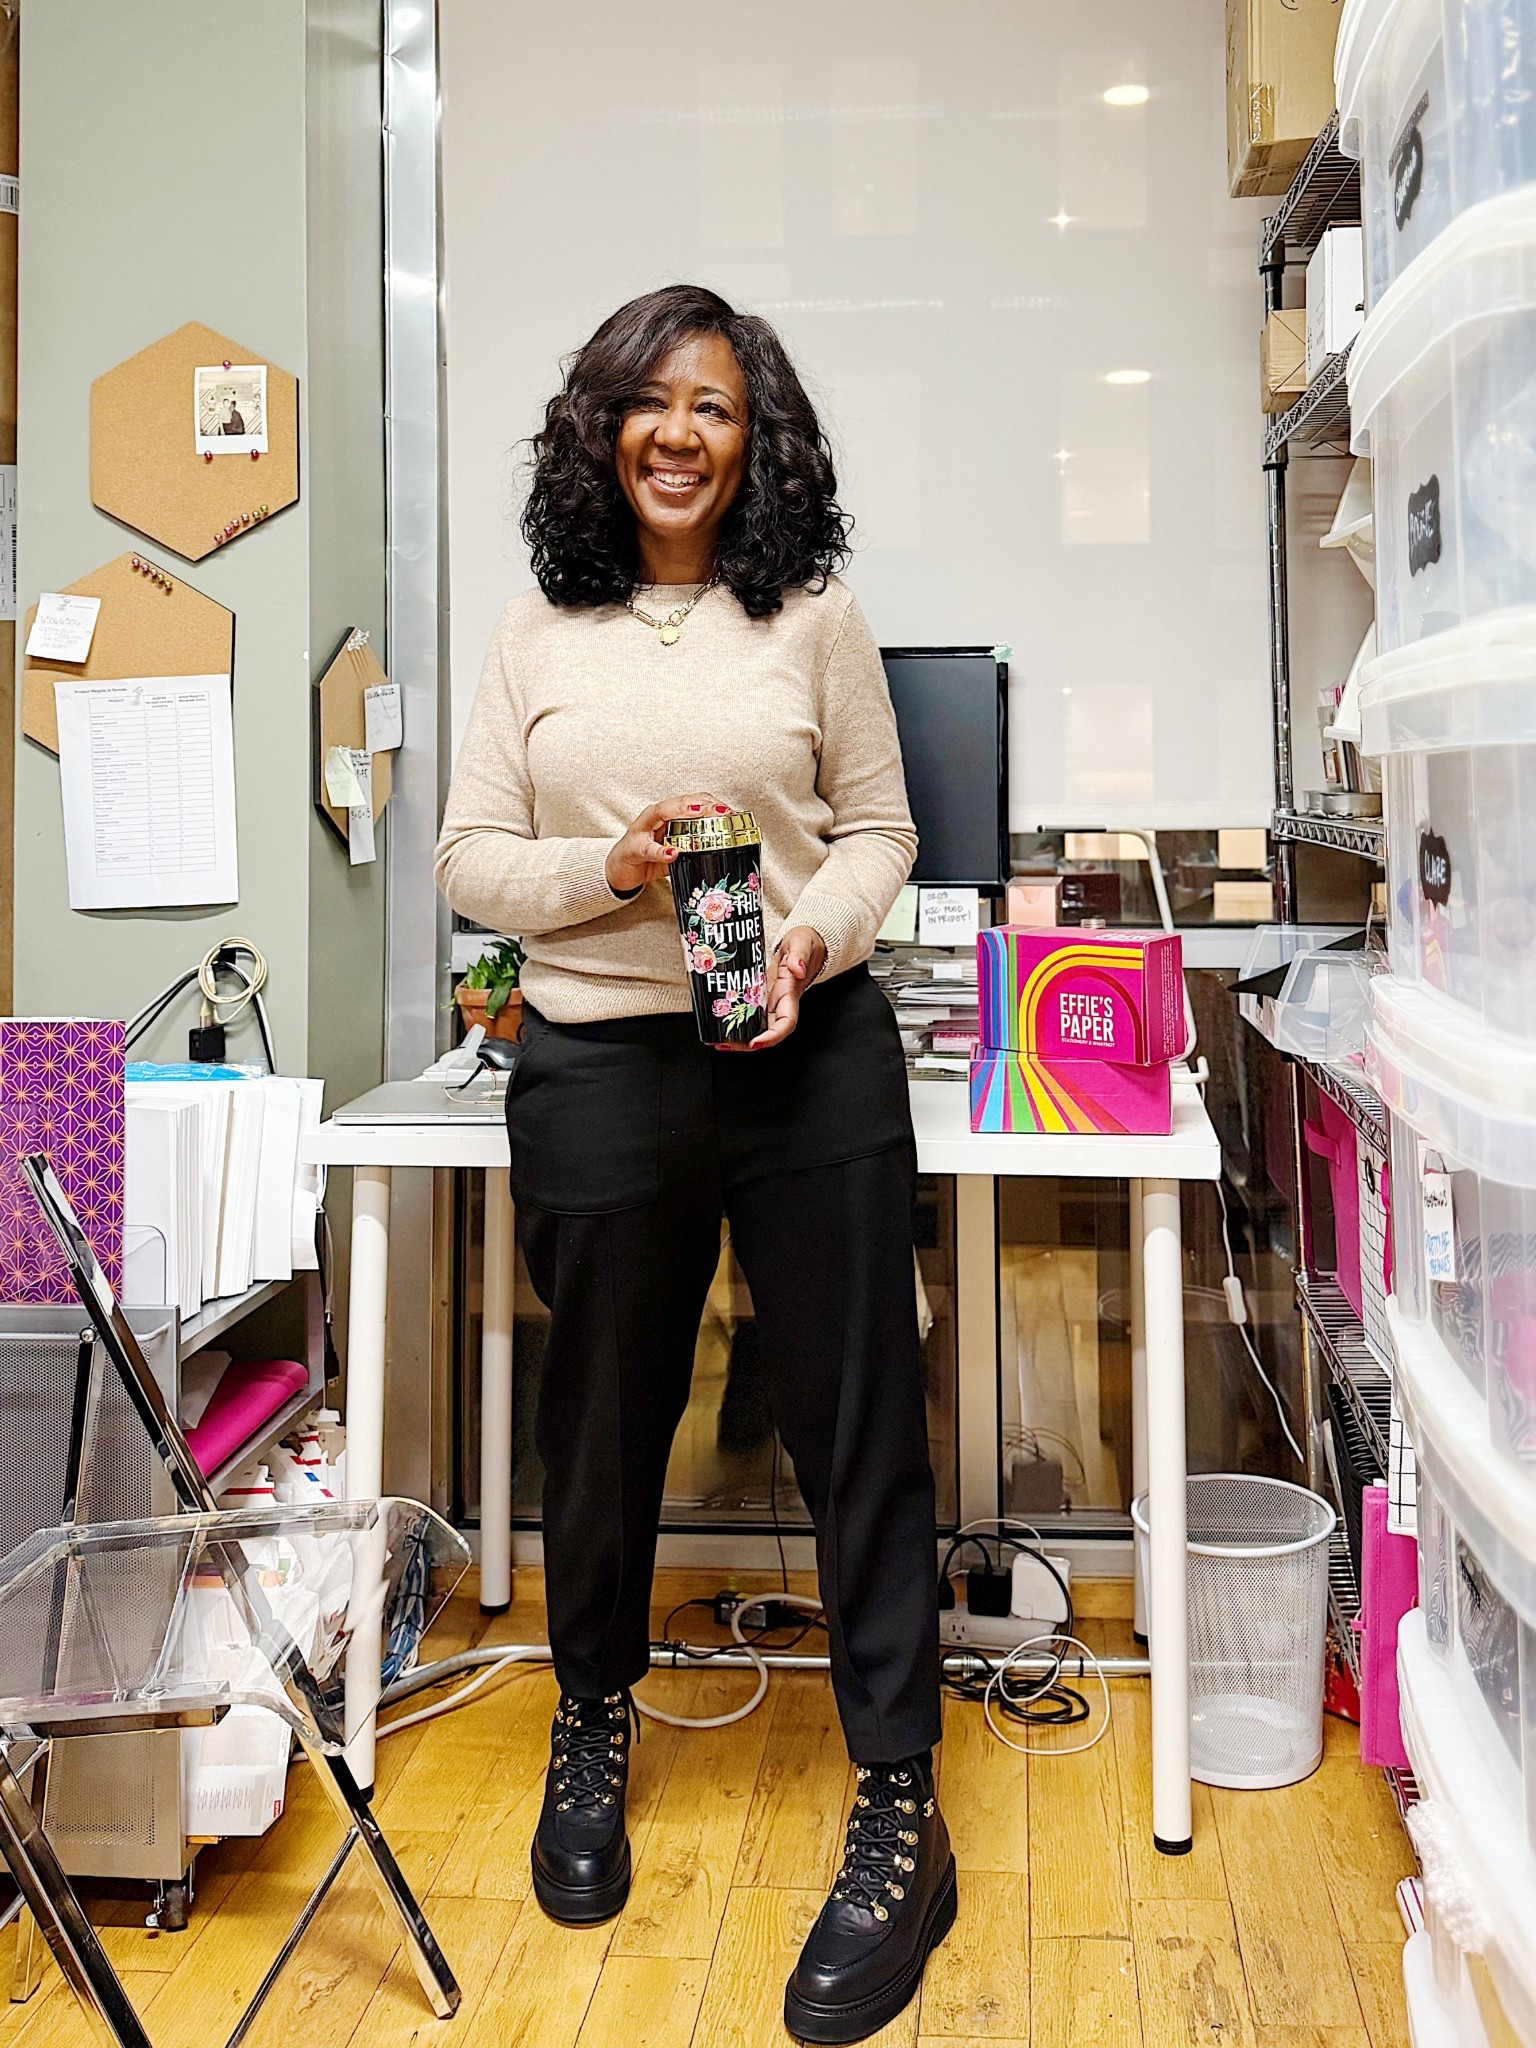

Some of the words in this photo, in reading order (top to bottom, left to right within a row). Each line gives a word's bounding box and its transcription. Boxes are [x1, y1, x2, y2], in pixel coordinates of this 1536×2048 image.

[736, 892, 760, 916] THE
[704, 916, 761, 944] FUTURE
[752, 941, 762, 963] IS
[706, 963, 764, 993] FEMALE
[1060, 992, 1113, 1018] EFFIE'S
[1061, 1013, 1115, 1042] PAPER
[1061, 1037, 1088, 1045] STATIONERY
